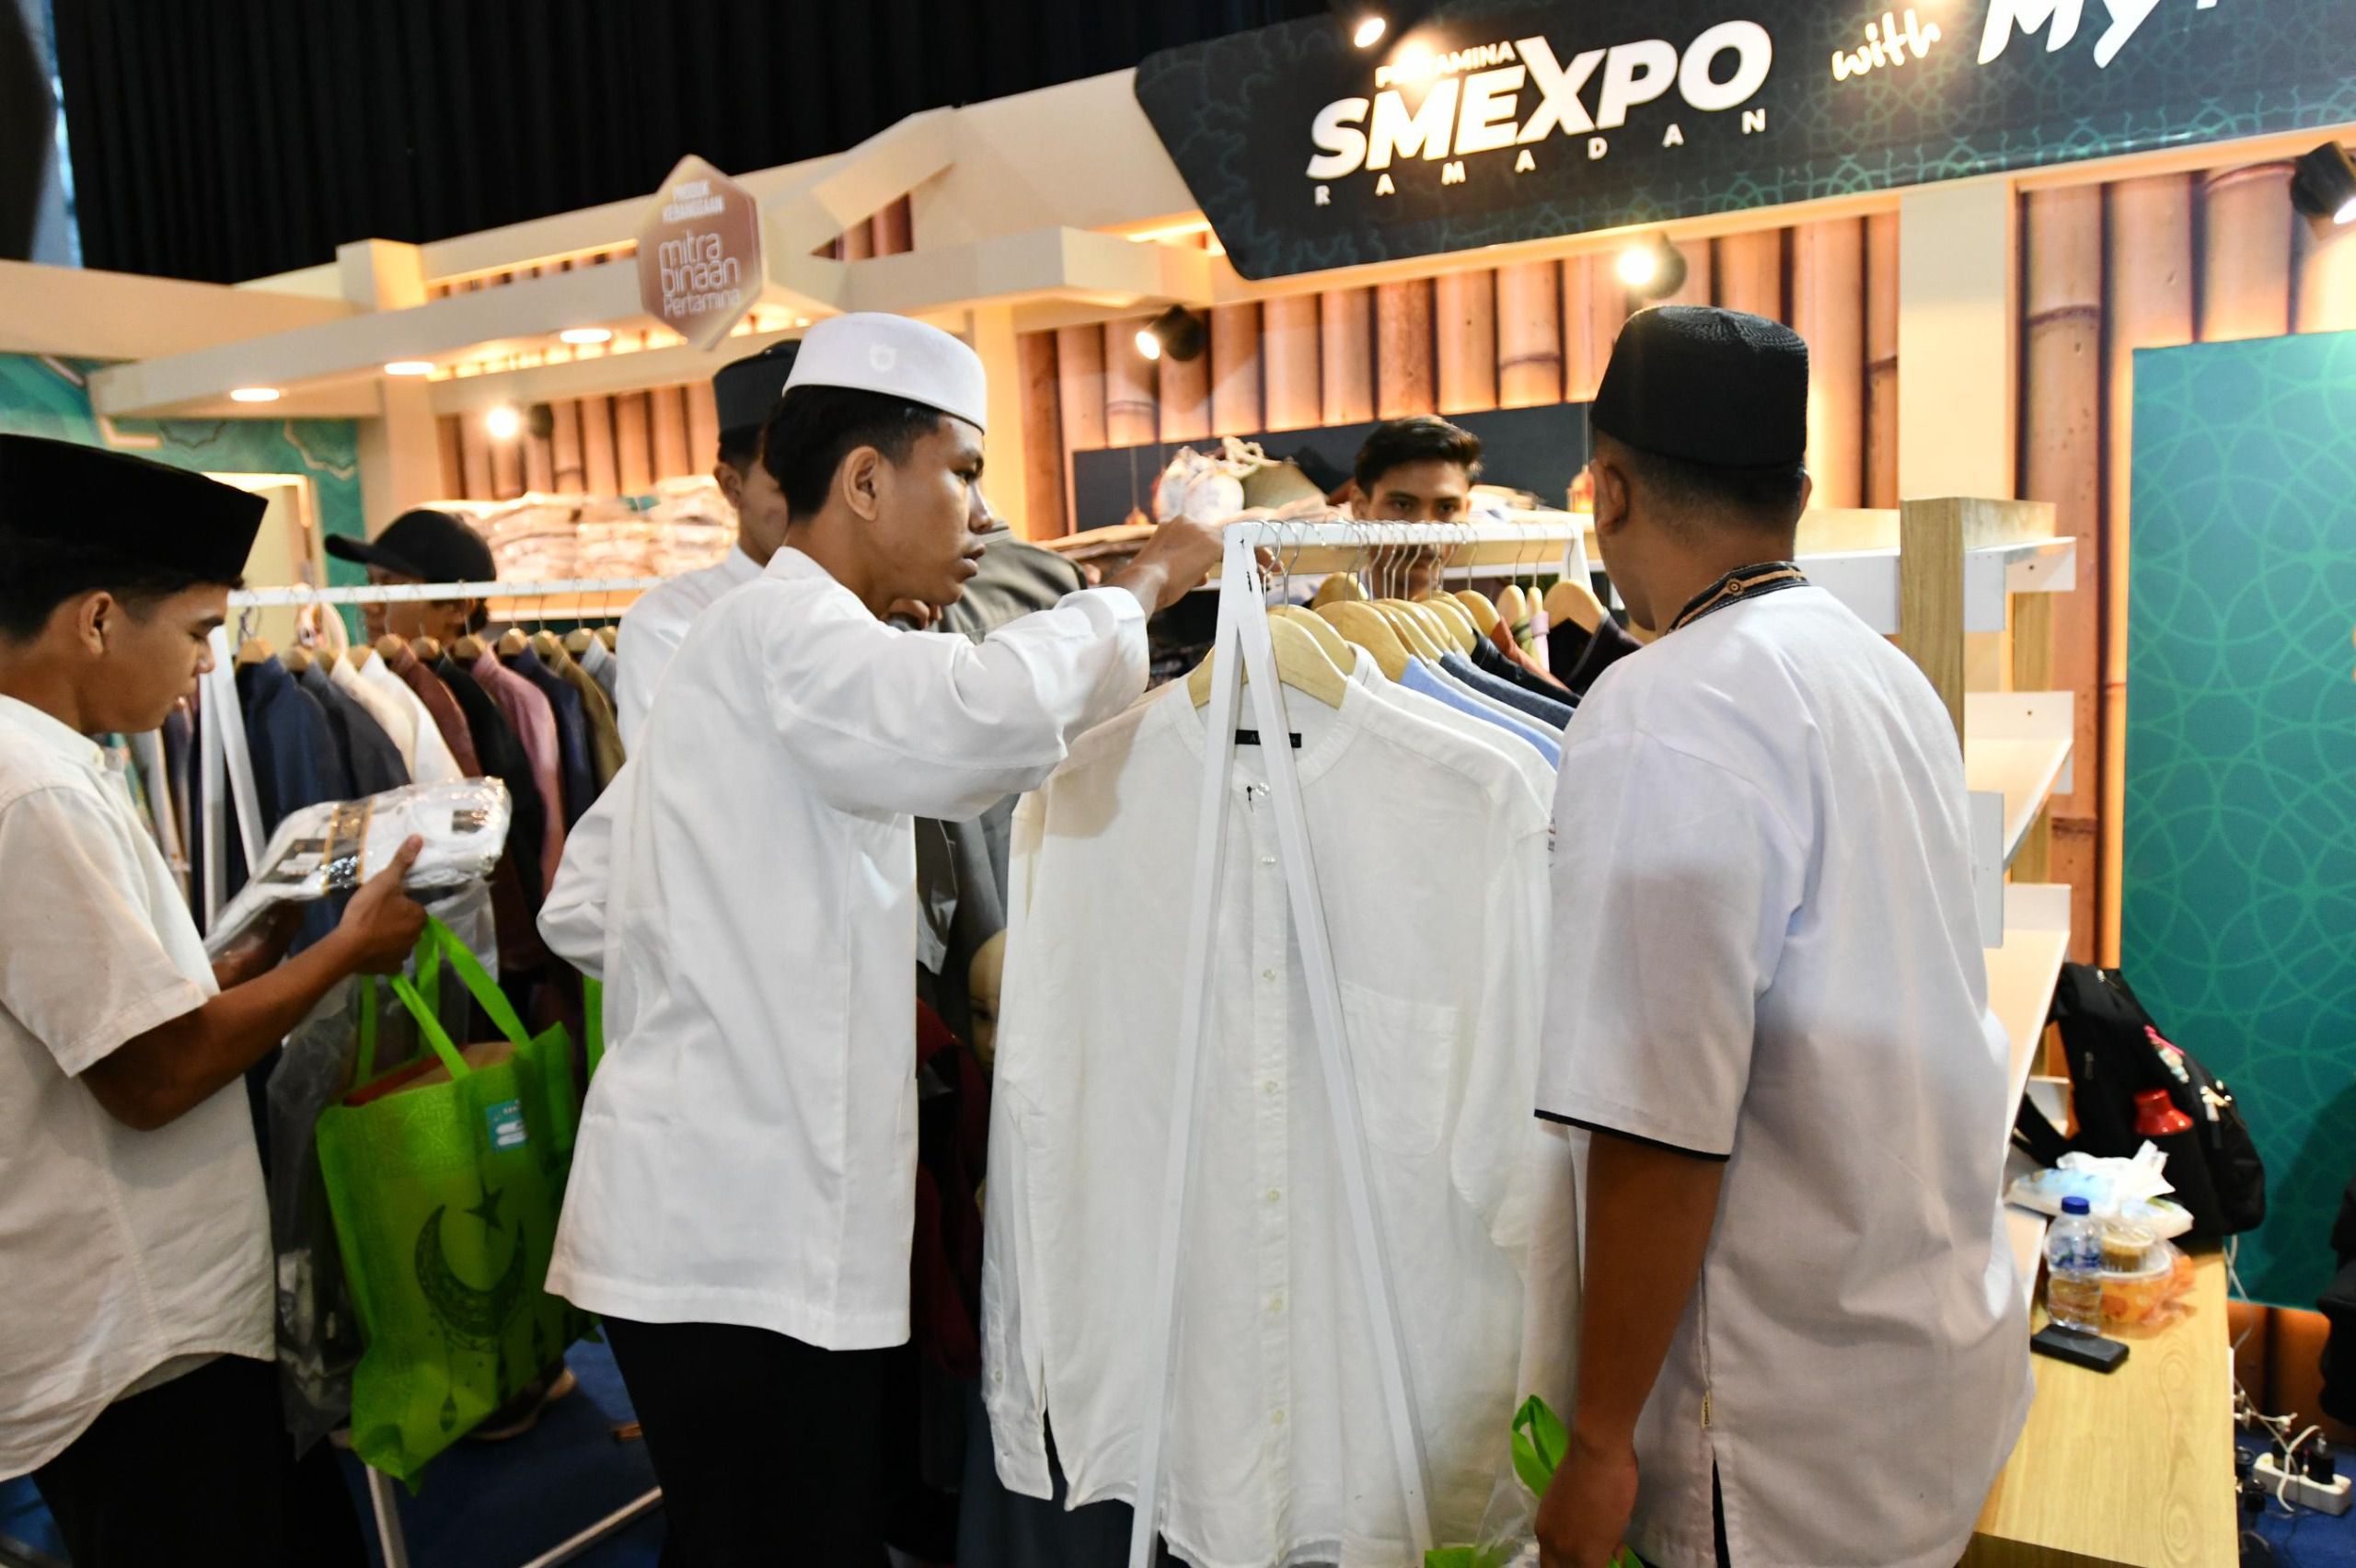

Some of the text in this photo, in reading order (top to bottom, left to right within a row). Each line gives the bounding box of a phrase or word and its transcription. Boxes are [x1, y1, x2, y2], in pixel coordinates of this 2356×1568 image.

[1375, 40, 1516, 88] PAMINA
[1831, 8, 1942, 82] with
[1305, 19, 1773, 180] SMEXPO
[1313, 108, 1766, 206] RAMADAN
[658, 229, 723, 267] mitra
[663, 288, 742, 318] Pertamina
